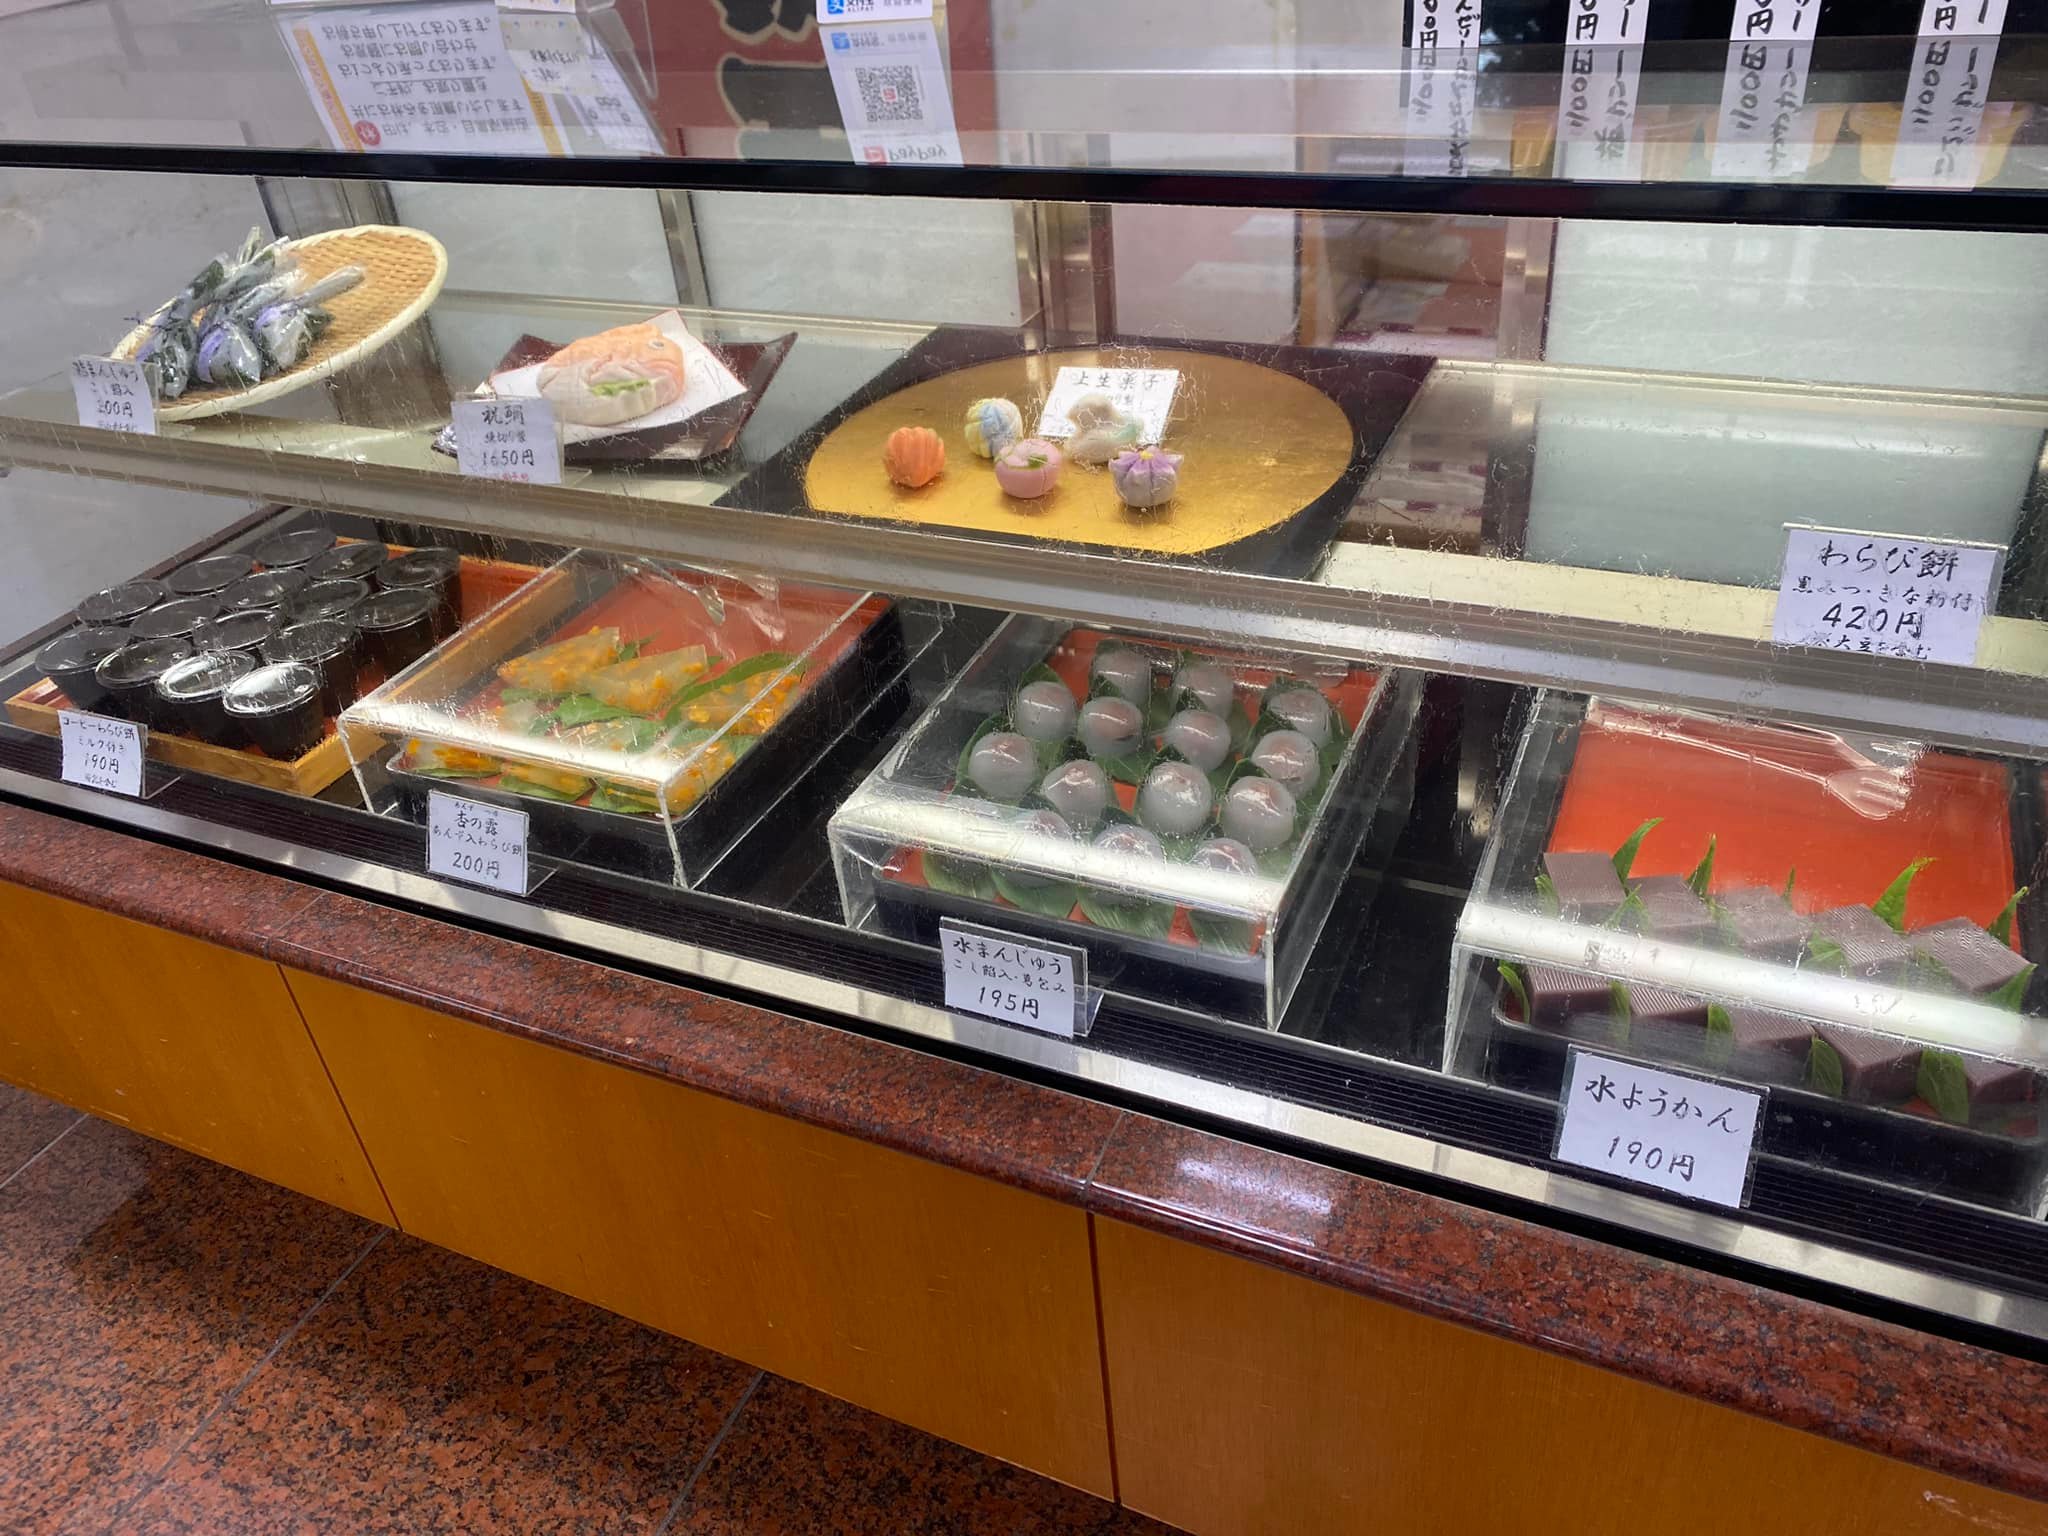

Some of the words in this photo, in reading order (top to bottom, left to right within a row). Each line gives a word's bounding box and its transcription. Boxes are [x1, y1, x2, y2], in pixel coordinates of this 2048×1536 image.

[1072, 371, 1159, 391] 上生菓子
[482, 448, 535, 466] 1650円
[1820, 540, 1959, 582] わらび餅
[1822, 602, 1924, 640] 420円
[84, 753, 119, 774] 190円
[454, 811, 499, 836] 杏の露
[452, 852, 500, 879] 200円
[953, 937, 1062, 975] 水まんじゅう
[978, 986, 1039, 1019] 195円
[1585, 1075, 1740, 1134] 水ようかん
[1608, 1136, 1695, 1182] 190円
